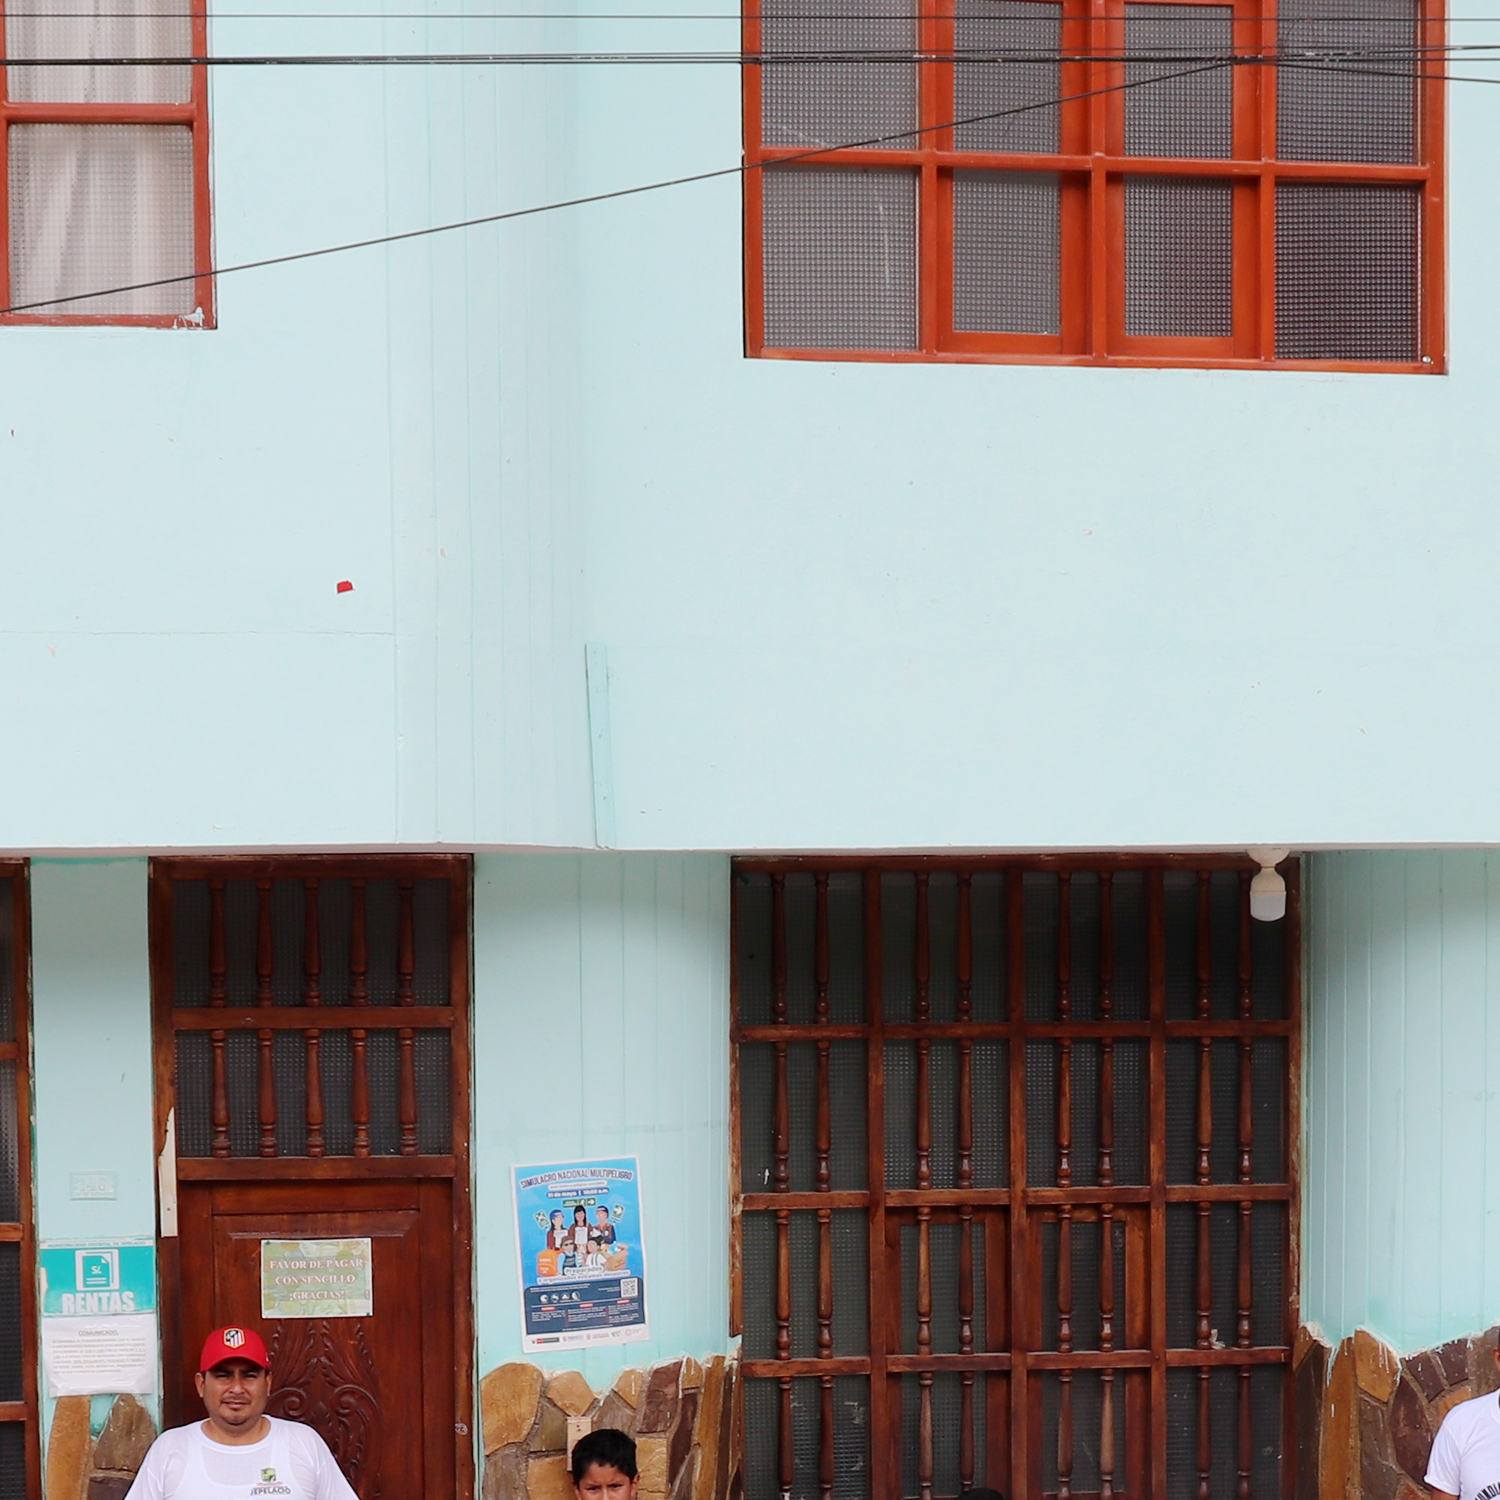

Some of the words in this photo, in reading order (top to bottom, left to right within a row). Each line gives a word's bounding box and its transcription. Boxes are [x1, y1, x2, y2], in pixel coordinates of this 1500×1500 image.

[520, 1173, 558, 1189] SIMULACRO
[558, 1169, 589, 1181] NACIONAL
[590, 1168, 633, 1180] MULTIPELIGRO
[270, 1260, 307, 1270] FAVOR
[309, 1260, 324, 1269] DE
[326, 1259, 364, 1268] PAGAR
[566, 1267, 603, 1275] Preparados
[275, 1276, 300, 1285] CON
[289, 1291, 345, 1301] ¡GRACIAS!
[61, 1291, 135, 1314] RENTAS
[250, 1487, 291, 1495] JEPELACIO
